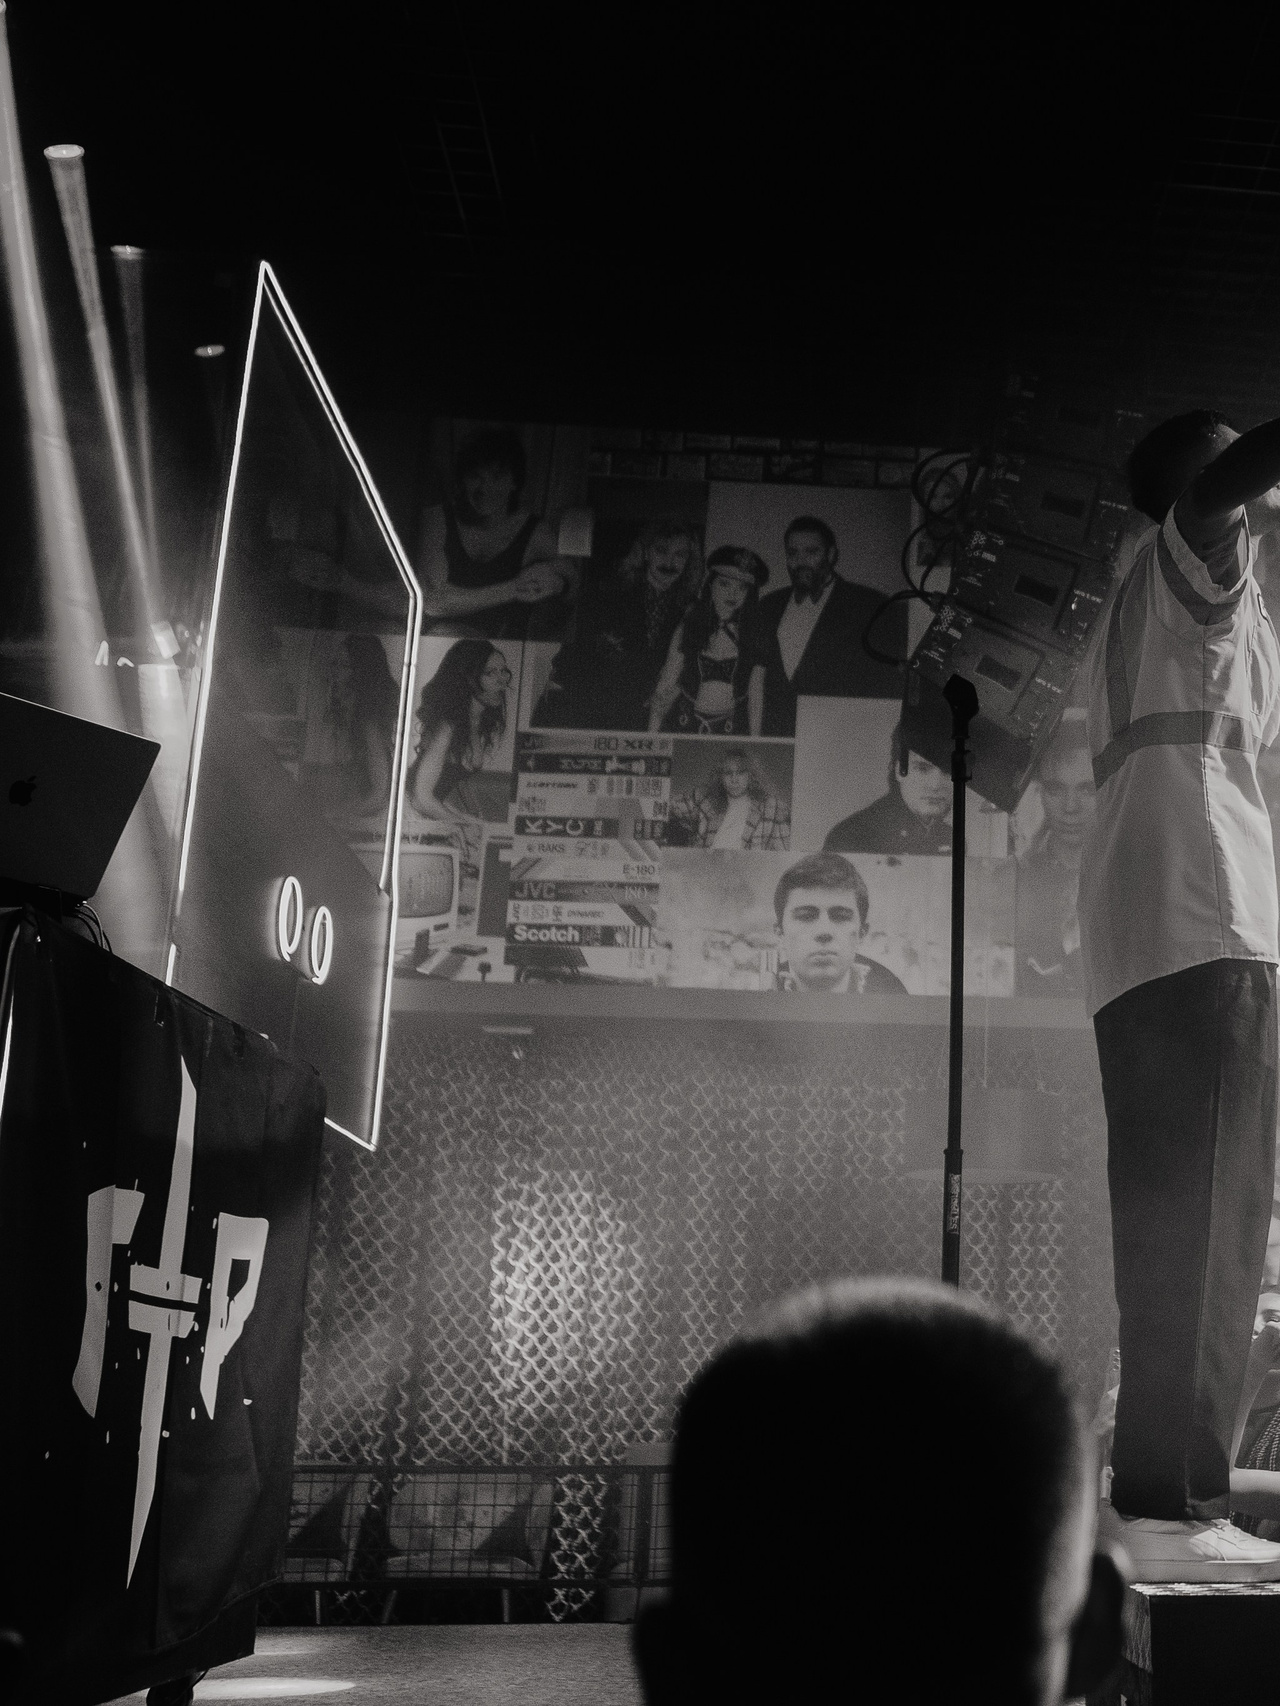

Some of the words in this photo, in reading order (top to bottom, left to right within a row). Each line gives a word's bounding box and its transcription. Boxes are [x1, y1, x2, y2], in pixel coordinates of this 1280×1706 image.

[537, 843, 566, 854] RAKS
[622, 863, 656, 876] E-180
[514, 881, 556, 899] JVC
[513, 925, 580, 943] Scotch
